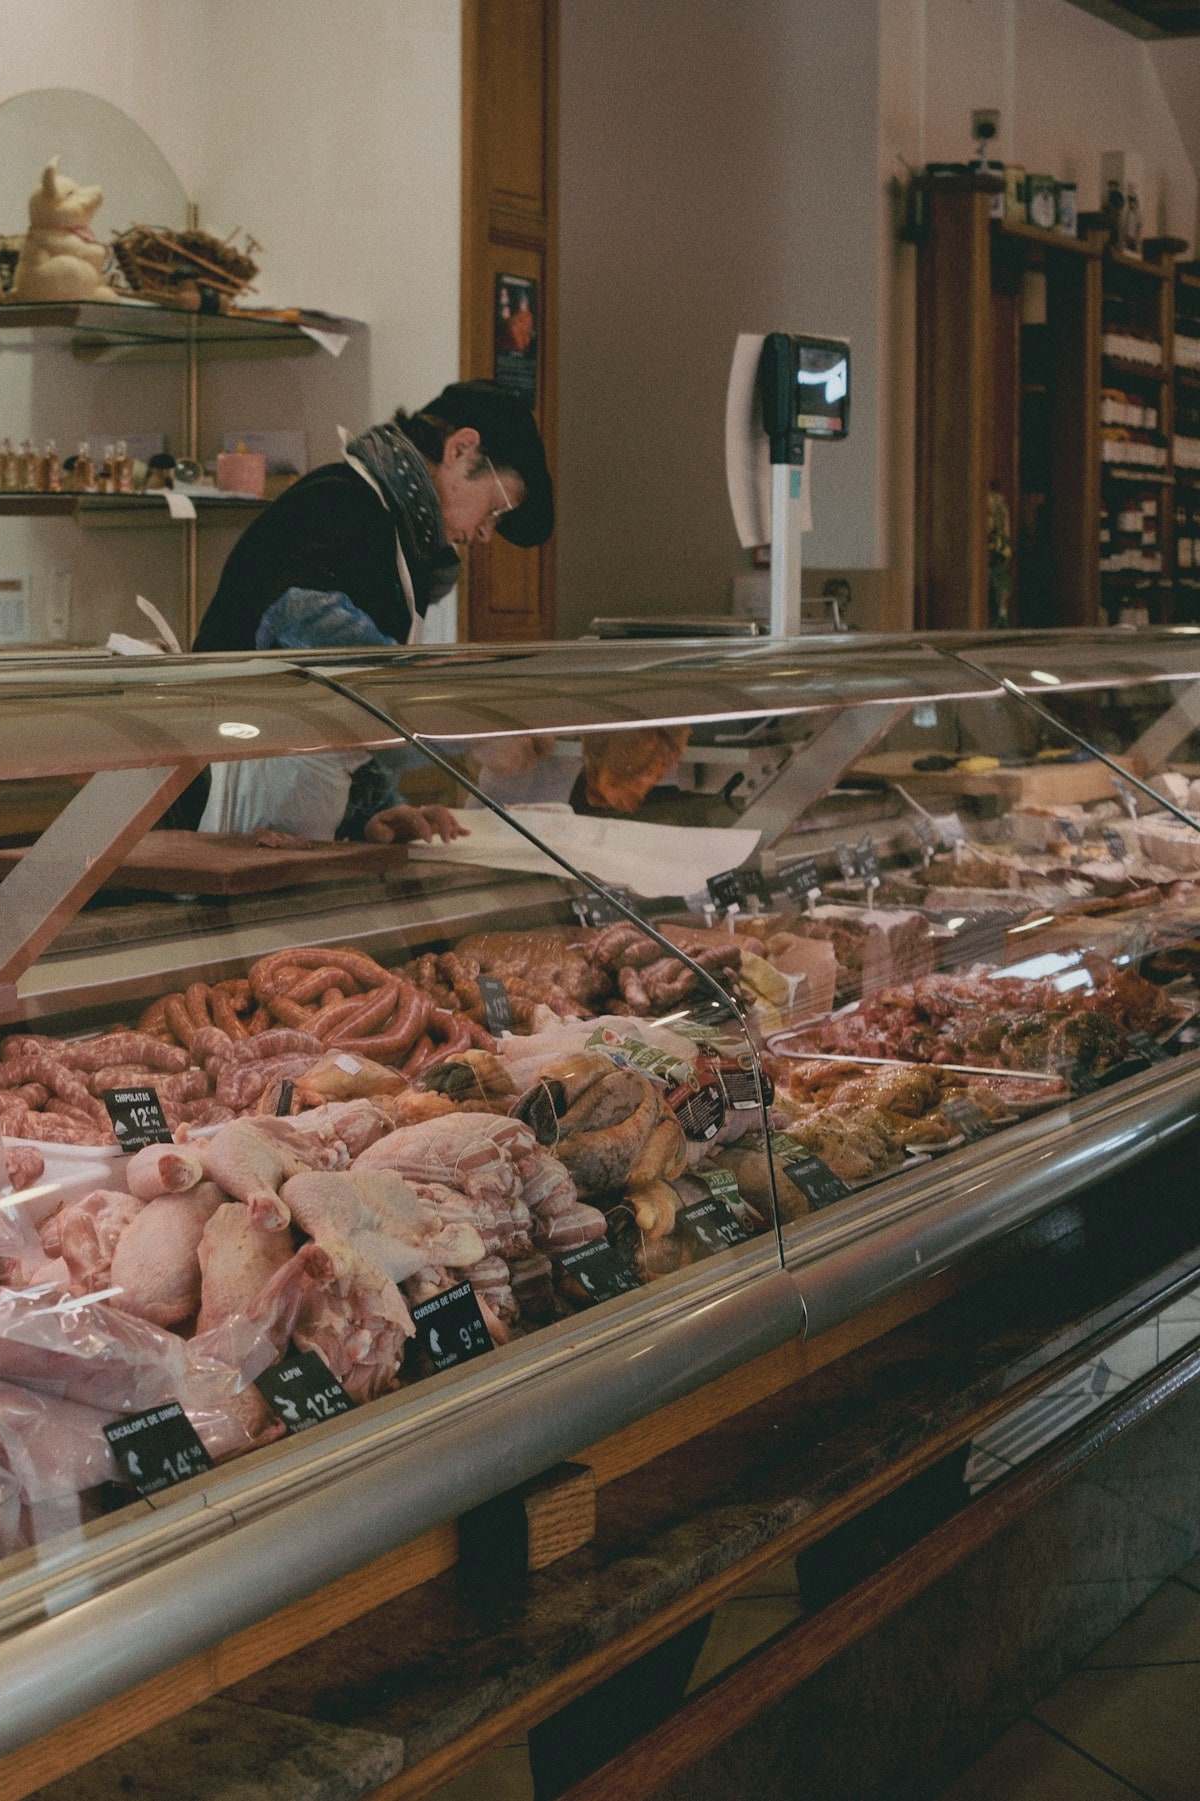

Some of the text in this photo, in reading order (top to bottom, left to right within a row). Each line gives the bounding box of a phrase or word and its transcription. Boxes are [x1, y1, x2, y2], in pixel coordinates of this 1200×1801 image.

[114, 1092, 151, 1103] CHIPOLATAS
[130, 1107, 150, 1128] 12
[413, 1282, 472, 1321] CUISSES DE POULET
[459, 1327, 473, 1350] 9
[278, 1366, 303, 1383] LAPIN
[305, 1393, 336, 1418] 12
[107, 1403, 183, 1442] ESCALOPE DE DINDE
[162, 1450, 192, 1482] 14
